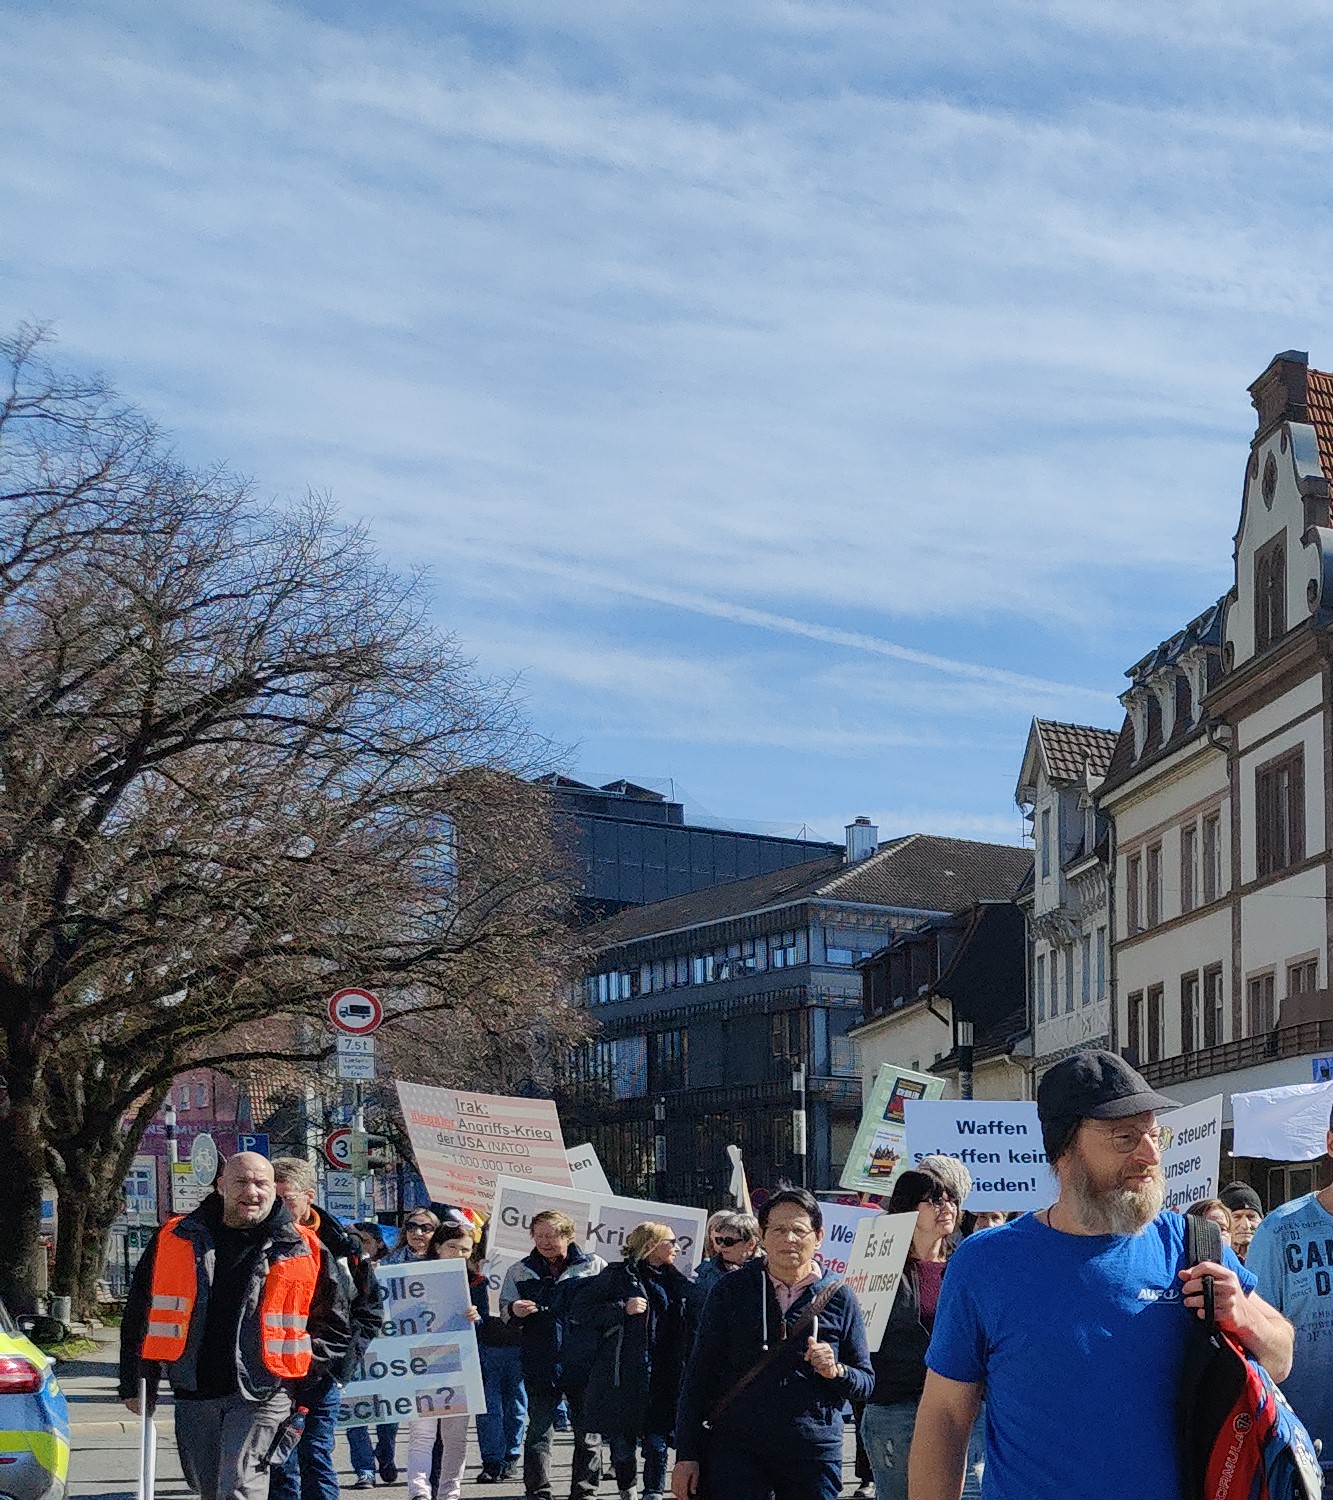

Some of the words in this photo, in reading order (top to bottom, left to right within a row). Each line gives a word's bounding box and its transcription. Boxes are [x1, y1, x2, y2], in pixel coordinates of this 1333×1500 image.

[458, 1117, 553, 1140] Angriffs-Krieg
[956, 1120, 1028, 1136] Waffen
[1177, 1117, 1217, 1147] steuert
[436, 1132, 455, 1145] der
[458, 1136, 485, 1150] USA
[488, 1142, 530, 1155] (NATO)
[507, 1161, 533, 1174] Tote
[914, 1149, 1001, 1164] saffen
[1164, 1156, 1202, 1179] unsere
[970, 1177, 1037, 1192] rieden!
[1161, 1177, 1212, 1211] edanken?
[864, 1233, 879, 1258] Es
[878, 1231, 895, 1257] ist
[868, 1271, 899, 1292] unser
[351, 1356, 428, 1381] lose
